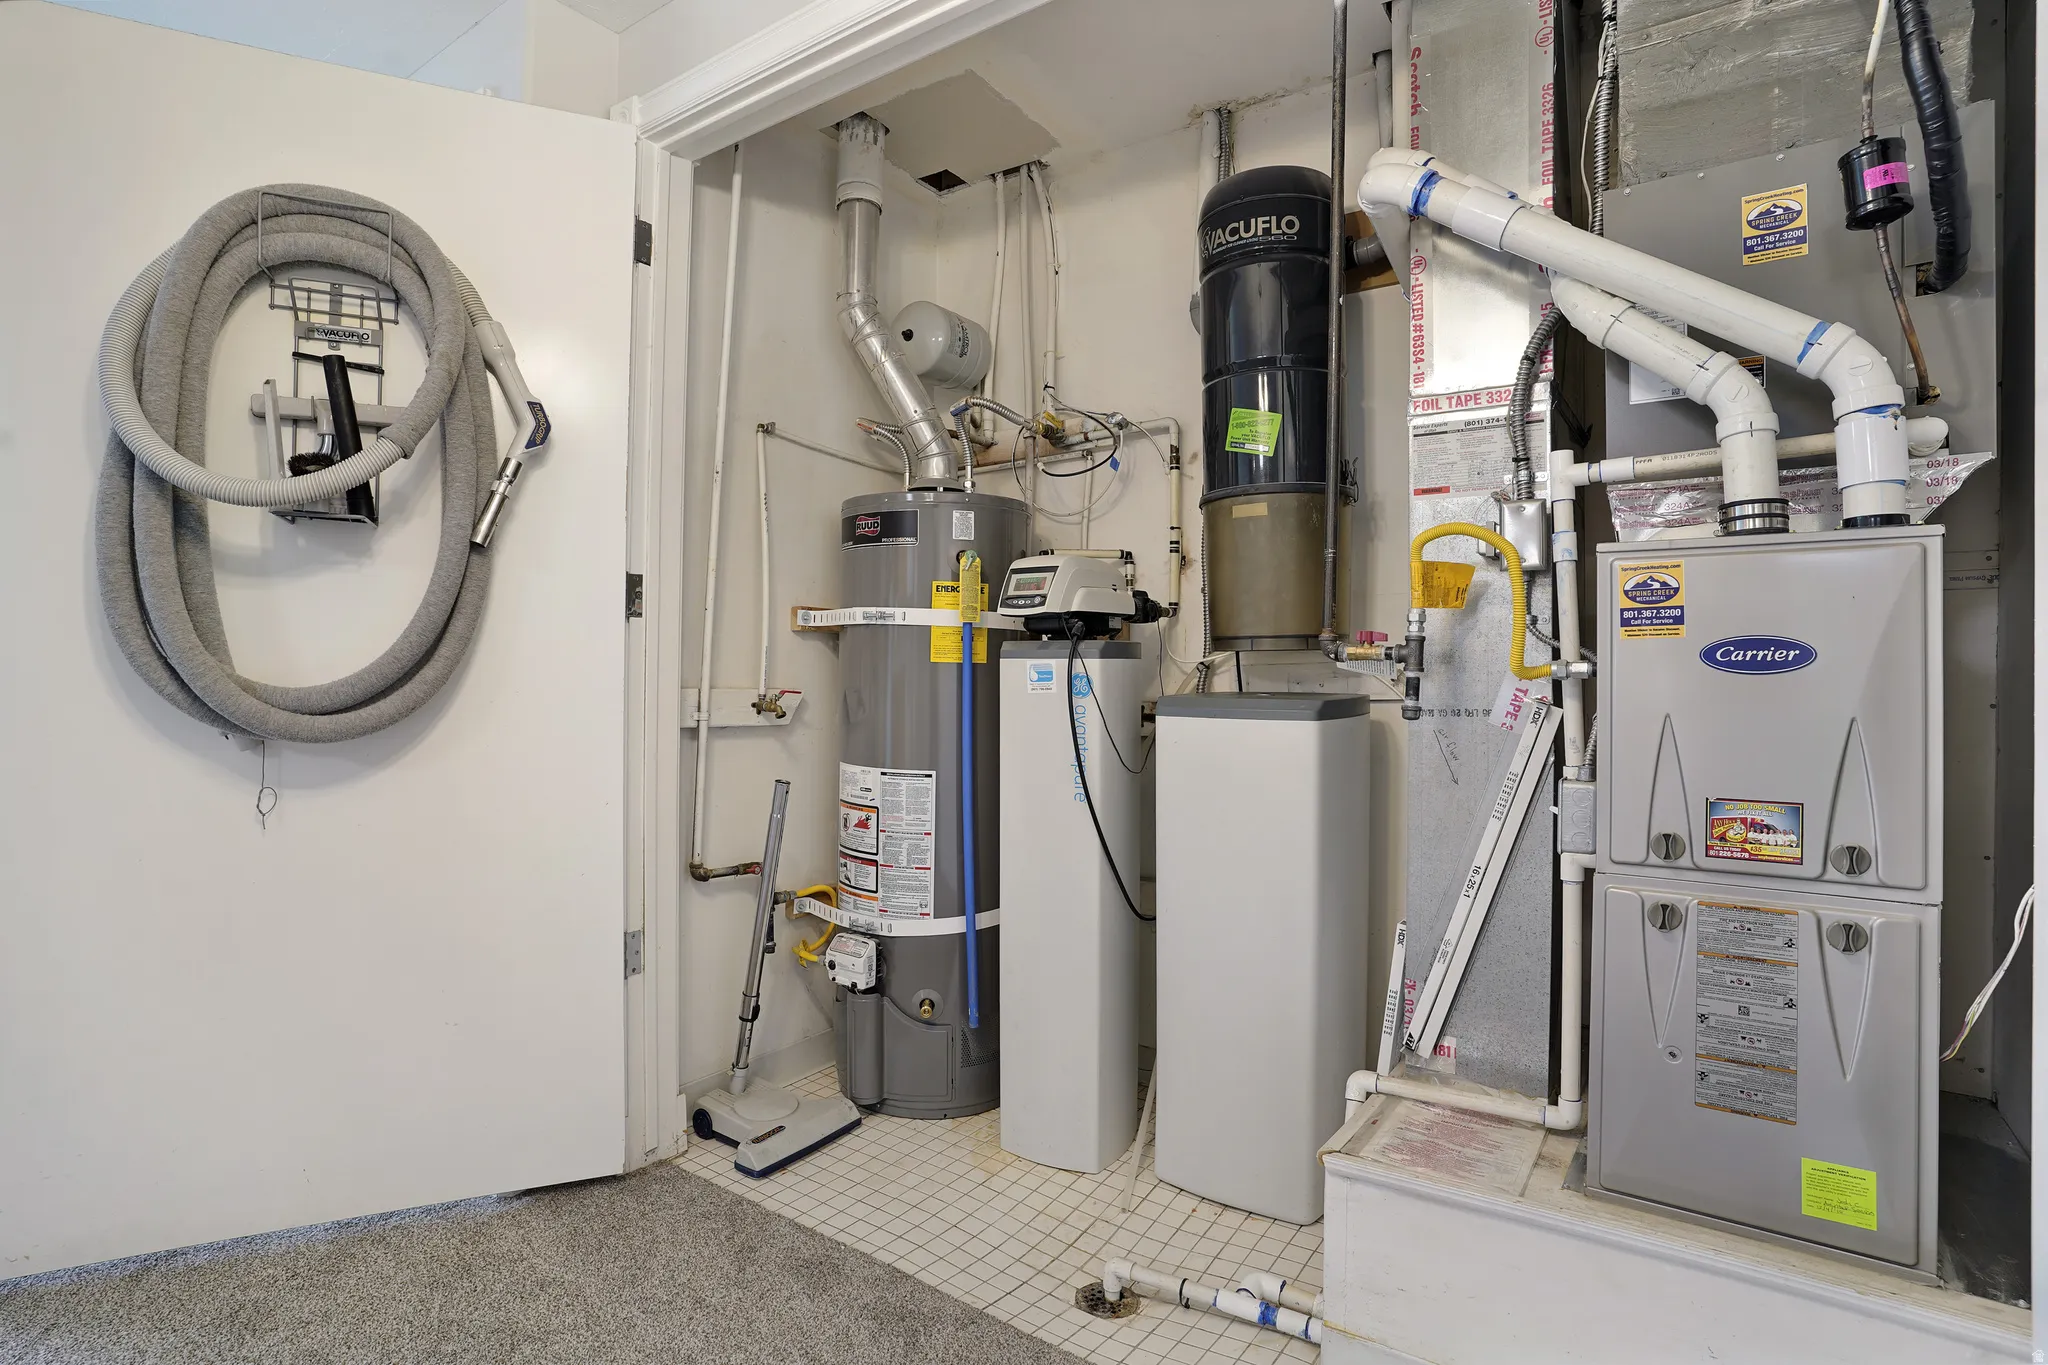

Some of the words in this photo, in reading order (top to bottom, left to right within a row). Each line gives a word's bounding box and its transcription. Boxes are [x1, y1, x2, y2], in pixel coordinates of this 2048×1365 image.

[1751, 216, 1775, 227] SPRING
[1776, 212, 1798, 222] CREEK
[1759, 220, 1790, 229] MECHANICAL
[1205, 214, 1300, 255] VACUFLO
[1746, 229, 1804, 247] 801.367.3200
[1775, 239, 1796, 247] Service
[1411, 282, 1424, 319] LISTED
[1413, 397, 1443, 412] FOIL
[1446, 393, 1482, 409] TAPE
[1485, 388, 1512, 404] 332
[1464, 419, 1484, 428] (801)
[1926, 457, 1959, 469] 03/18
[1926, 475, 1958, 487] 03/18
[1664, 485, 1690, 495] 324A
[1664, 501, 1690, 511] 324A
[856, 520, 880, 531] RUUD
[1664, 517, 1691, 527] 324A
[1621, 564, 1681, 572] SpringCreekHeating.com
[1623, 609, 1681, 619] 801.367.3200
[1715, 646, 1800, 662] Carrier
[1504, 687, 1529, 722] TAPE
[1530, 706, 1544, 726] HDX
[1750, 803, 1763, 811] TOO
[1764, 805, 1786, 814] SMALL
[1396, 928, 1406, 947] HDX
